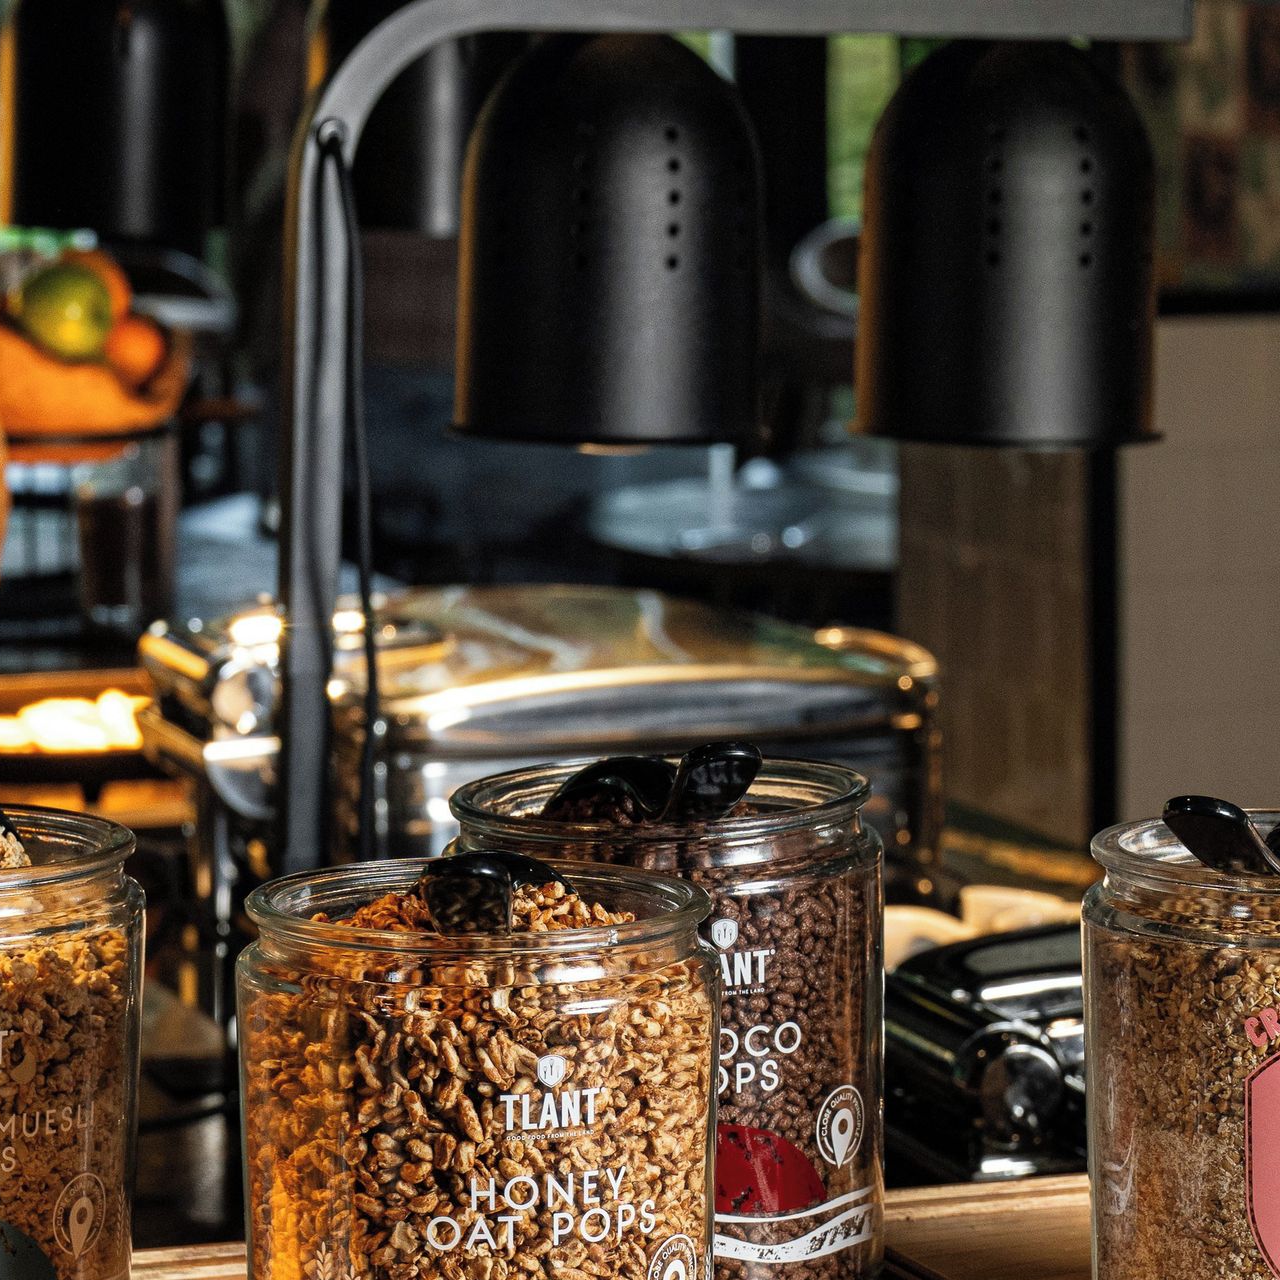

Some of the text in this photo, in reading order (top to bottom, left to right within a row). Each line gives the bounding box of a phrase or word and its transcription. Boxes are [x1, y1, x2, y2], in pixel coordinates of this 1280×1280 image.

[500, 1087, 600, 1131] TLANT
[821, 1108, 832, 1137] CLOSE
[830, 1092, 853, 1108] QUALITY
[471, 1166, 627, 1211] HONEY
[426, 1200, 656, 1251] OAT POPS
[662, 1243, 686, 1260] QUALITY
